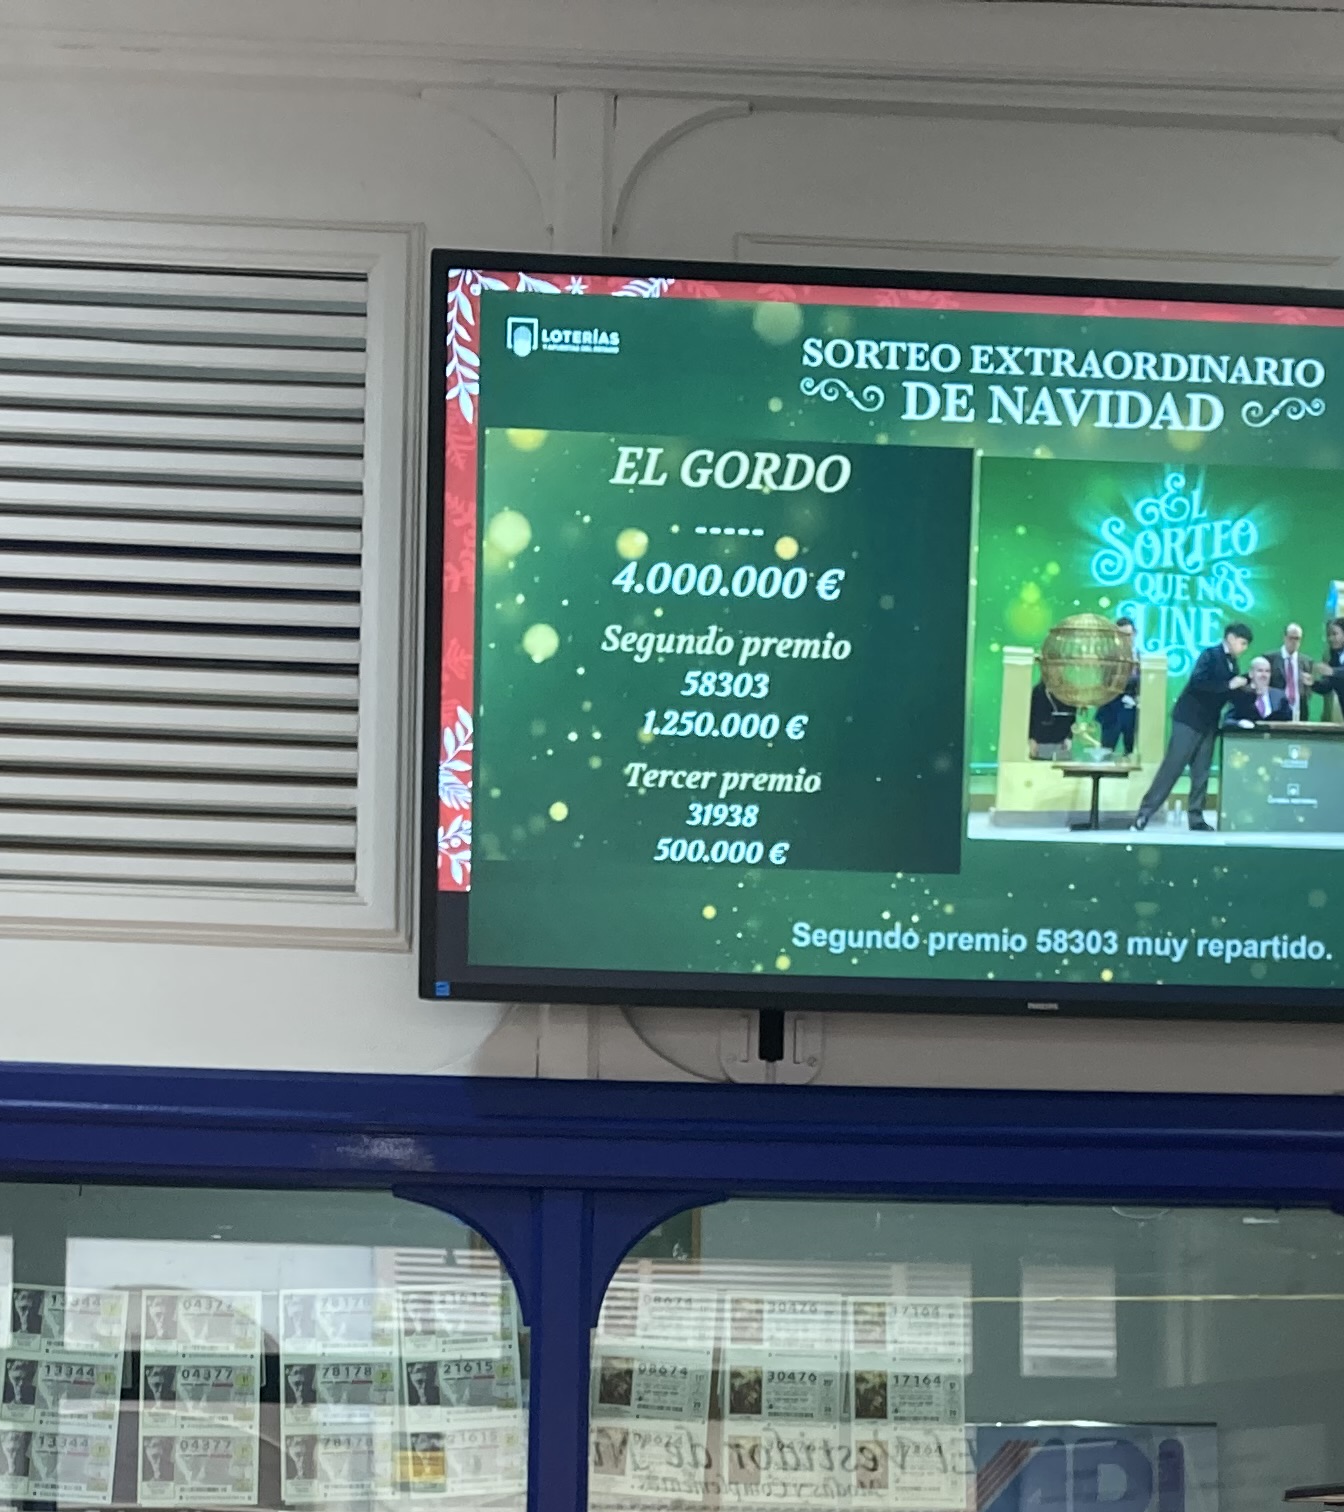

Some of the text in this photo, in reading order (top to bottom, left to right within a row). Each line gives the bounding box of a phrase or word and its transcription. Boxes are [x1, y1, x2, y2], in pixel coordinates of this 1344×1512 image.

[541, 328, 620, 346] LOTERÍAS
[802, 337, 1326, 388] SORTEO EXTRAORDINARIO
[901, 381, 1225, 432] DE NAVIDAD
[608, 446, 852, 493] EL GORDO
[1091, 517, 1258, 586] SORTEO
[612, 561, 846, 600] 4.000.000 €
[1133, 572, 1191, 603] QUE
[601, 624, 852, 667] Segundo premio
[680, 670, 770, 698] 58303
[643, 710, 809, 740] 1.250.000 €
[626, 762, 822, 799] Tercer premio
[686, 803, 759, 827] 31938
[653, 838, 791, 865] 500.000 €
[792, 922, 1334, 963] Segundo premio 58303 muy repartido.
[180, 1368, 234, 1380] 04377
[321, 1366, 373, 1378] 78178
[442, 1361, 494, 1374] 21615
[766, 1371, 818, 1384] 30476
[892, 1374, 943, 1386] 17164
[179, 1439, 232, 1451] 04377
